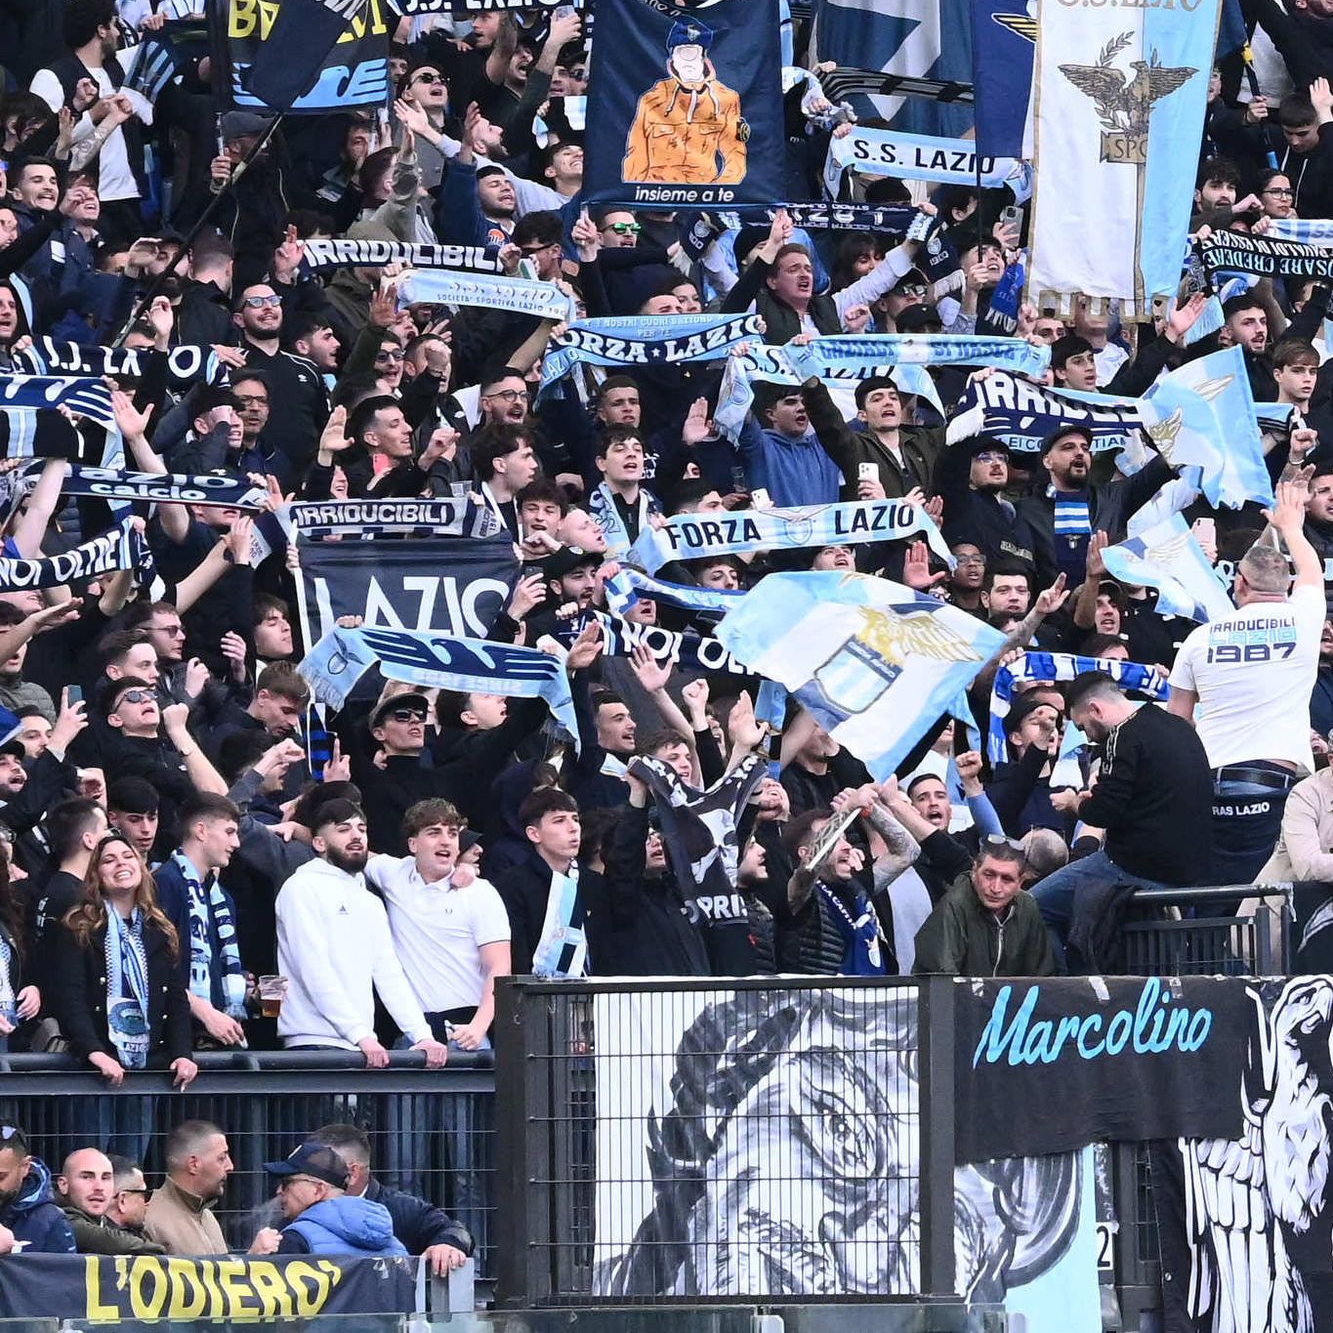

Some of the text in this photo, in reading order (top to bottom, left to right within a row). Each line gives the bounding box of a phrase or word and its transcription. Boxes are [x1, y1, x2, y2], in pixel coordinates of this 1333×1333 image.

[853, 139, 996, 176] S.S. LAZIO
[634, 186, 735, 203] insieme a te
[1202, 247, 1275, 276] CREDERE
[474, 295, 543, 312] SPORTIVA LAZIO
[638, 316, 666, 326] CUORI
[666, 315, 760, 362] LAZIO
[85, 465, 241, 490] azio
[89, 482, 207, 501] calcio
[296, 503, 449, 527] IRRIDUCIBILI
[666, 504, 915, 554] FORZA LAZIO
[1209, 615, 1297, 633] IRRIDUCIBILI
[1208, 628, 1297, 644] LAZIO
[1207, 642, 1298, 664] 1987
[1235, 802, 1270, 816] LAZIO
[972, 976, 1212, 1068] Marcolino
